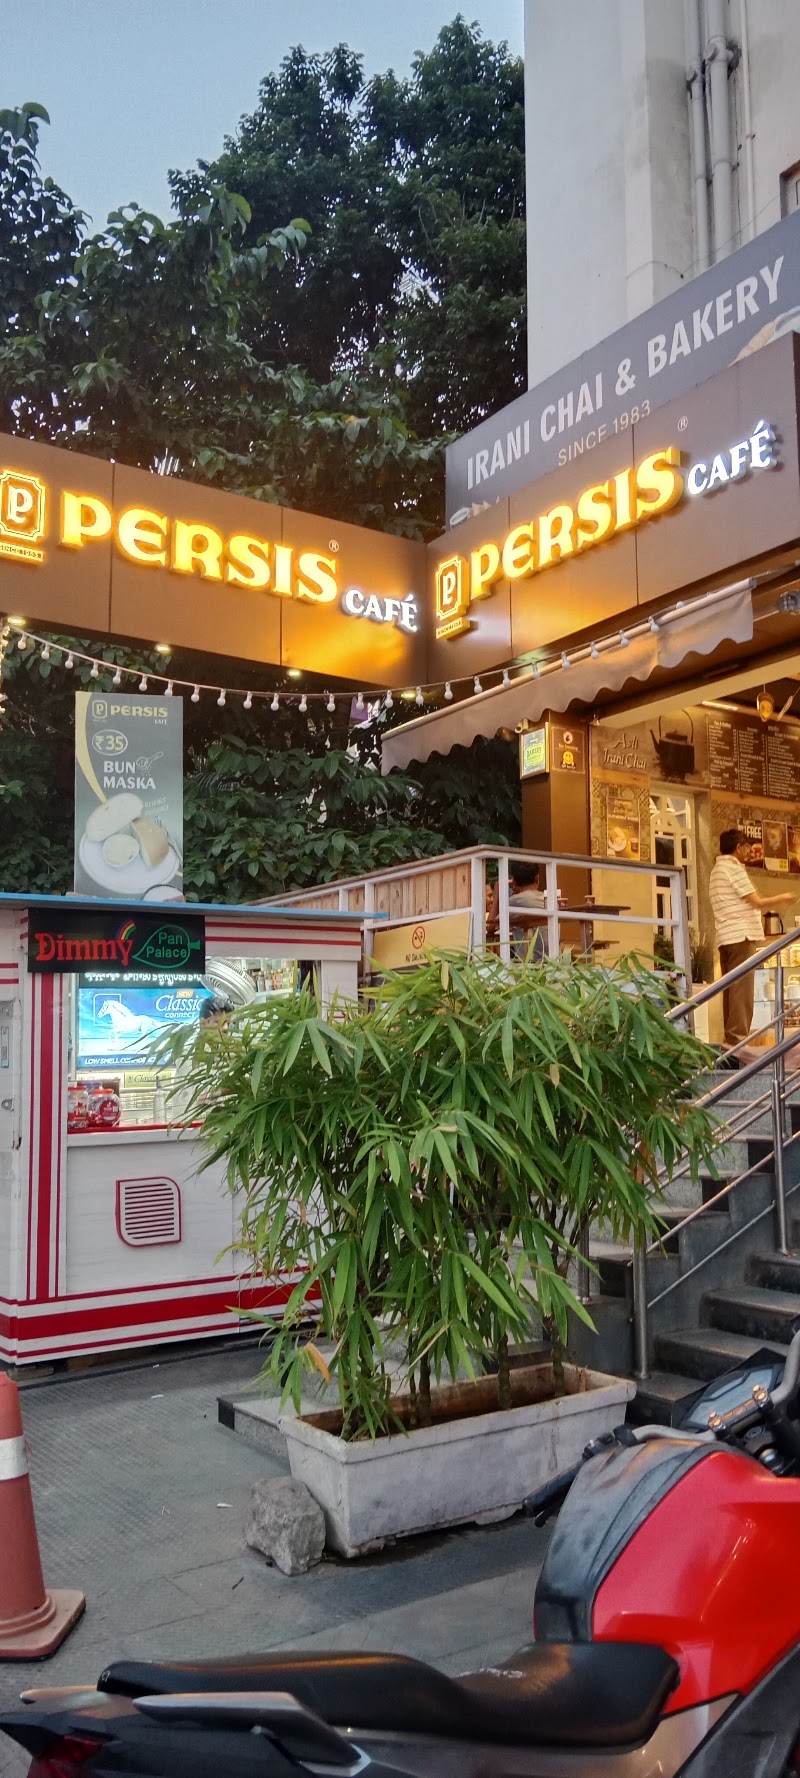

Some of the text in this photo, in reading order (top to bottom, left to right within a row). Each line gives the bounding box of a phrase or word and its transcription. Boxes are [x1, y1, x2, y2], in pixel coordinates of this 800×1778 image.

[467, 255, 785, 491] IRANI CHAI & BAKERY
[558, 400, 651, 467] SINCE 1983
[470, 420, 780, 600] PERSIS CAFÉ
[59, 490, 419, 633] PERSIS CAFÉ
[110, 704, 169, 718] PERSIS
[103, 761, 136, 774] BUN
[103, 776, 156, 790] MASKA
[34, 932, 183, 966] Dimmy Pan
[146, 946, 187, 959] Palace
[85, 1057, 100, 1065] LOW
